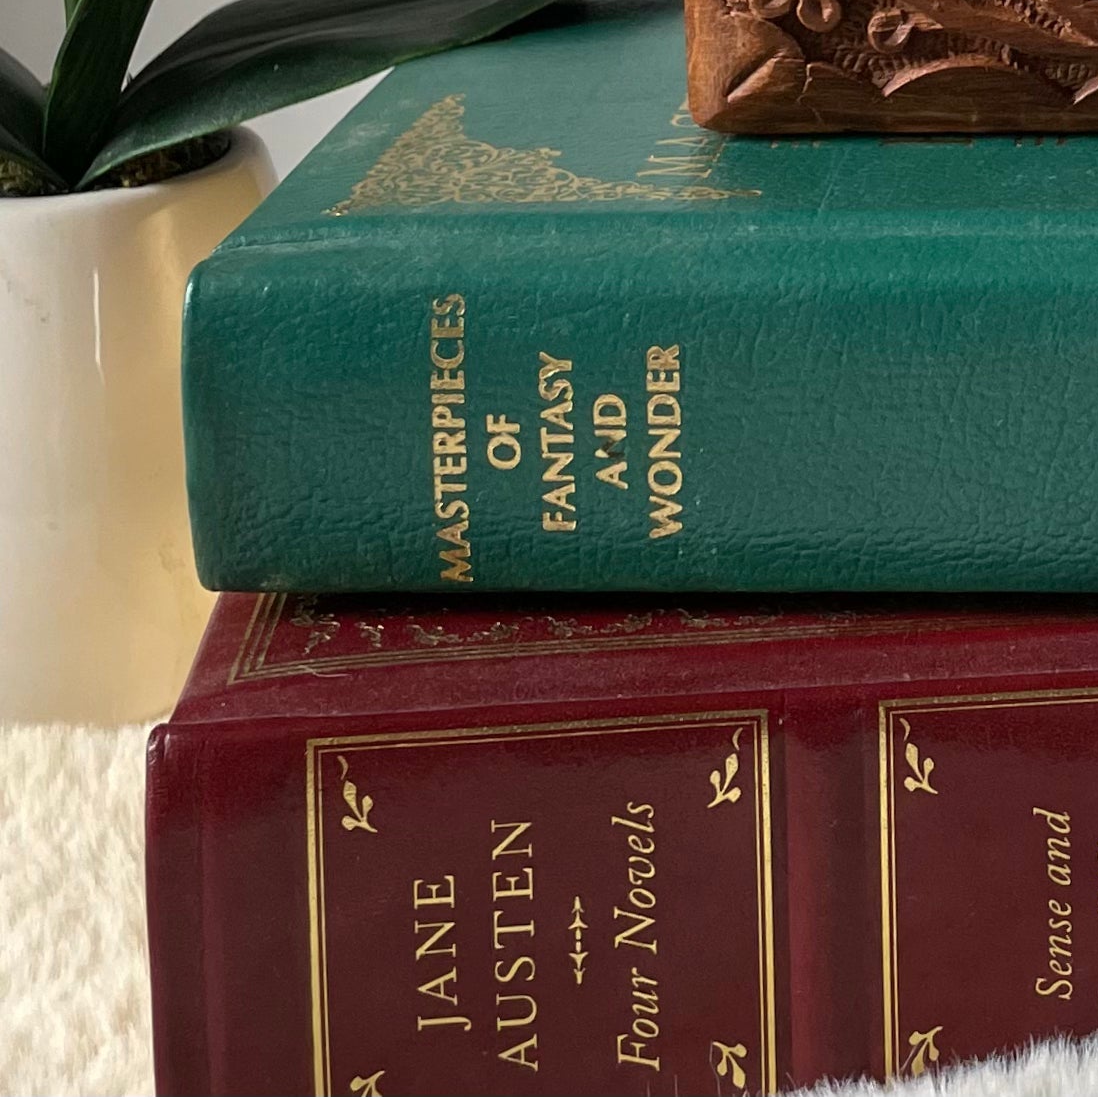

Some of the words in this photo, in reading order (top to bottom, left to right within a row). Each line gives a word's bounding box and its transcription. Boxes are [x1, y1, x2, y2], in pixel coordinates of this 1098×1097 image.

[430, 293, 474, 582] MASTERPIECES
[486, 413, 522, 470] OF
[538, 351, 576, 532] FANTASY
[592, 393, 628, 490] AND
[645, 344, 683, 539] WONDER
[611, 801, 658, 955] Novels
[1032, 807, 1072, 886] and
[413, 874, 472, 1031] JANE
[490, 819, 539, 1072] AUSTEN
[616, 967, 661, 1072] Four
[1034, 899, 1073, 1001] Sense
